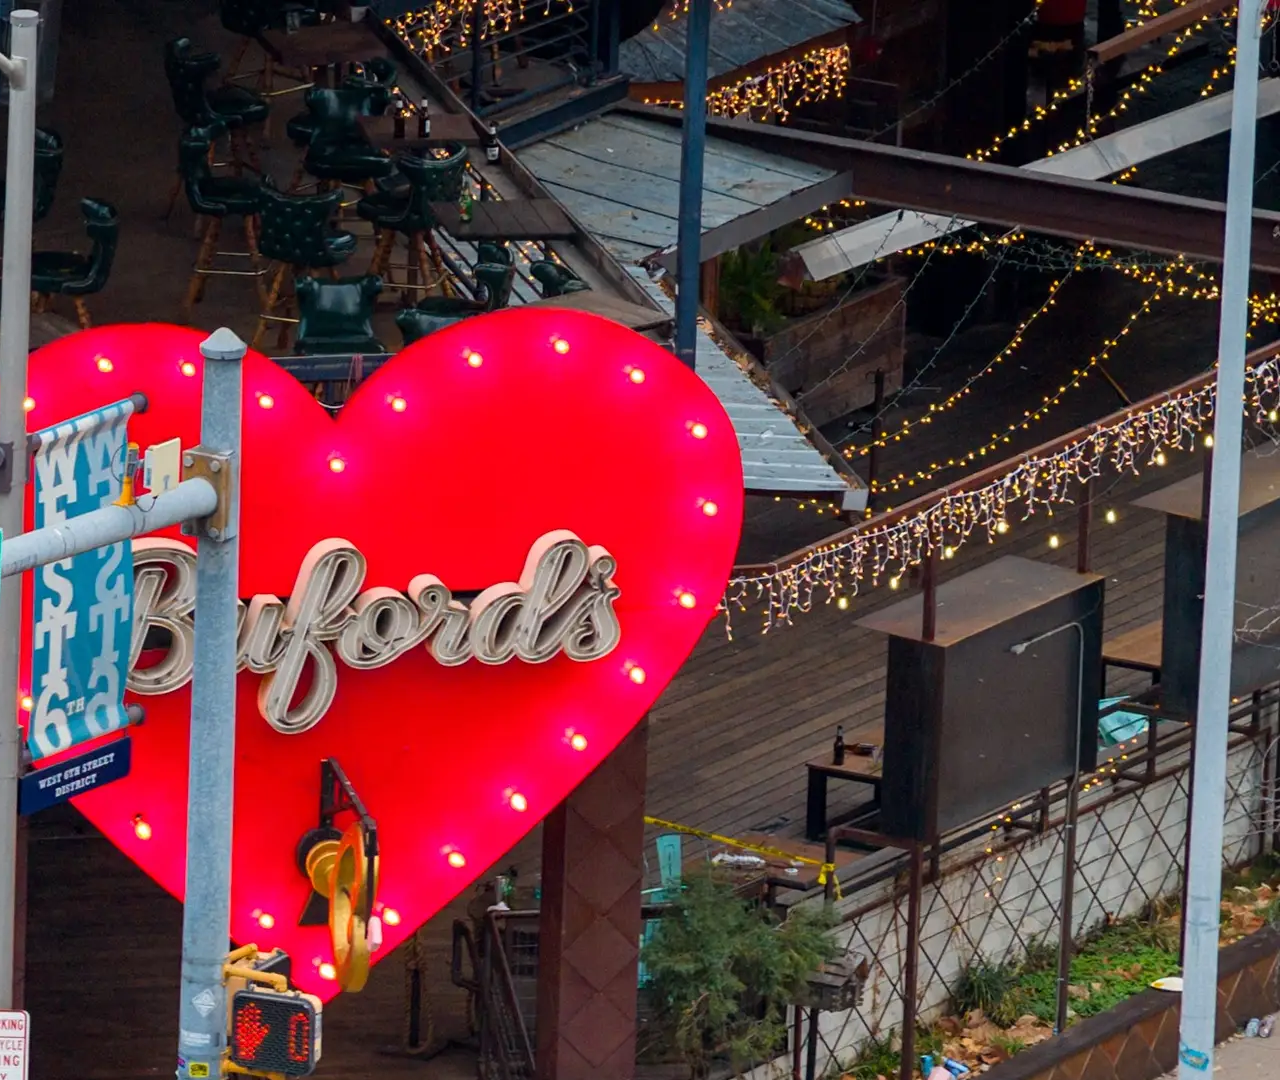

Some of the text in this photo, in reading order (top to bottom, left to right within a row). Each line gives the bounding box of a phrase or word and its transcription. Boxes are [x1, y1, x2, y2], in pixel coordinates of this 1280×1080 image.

[126, 529, 621, 735] Buford's
[39, 773, 62, 789] WEST
[82, 753, 115, 773] STREET
[55, 773, 97, 797] DISTRICT
